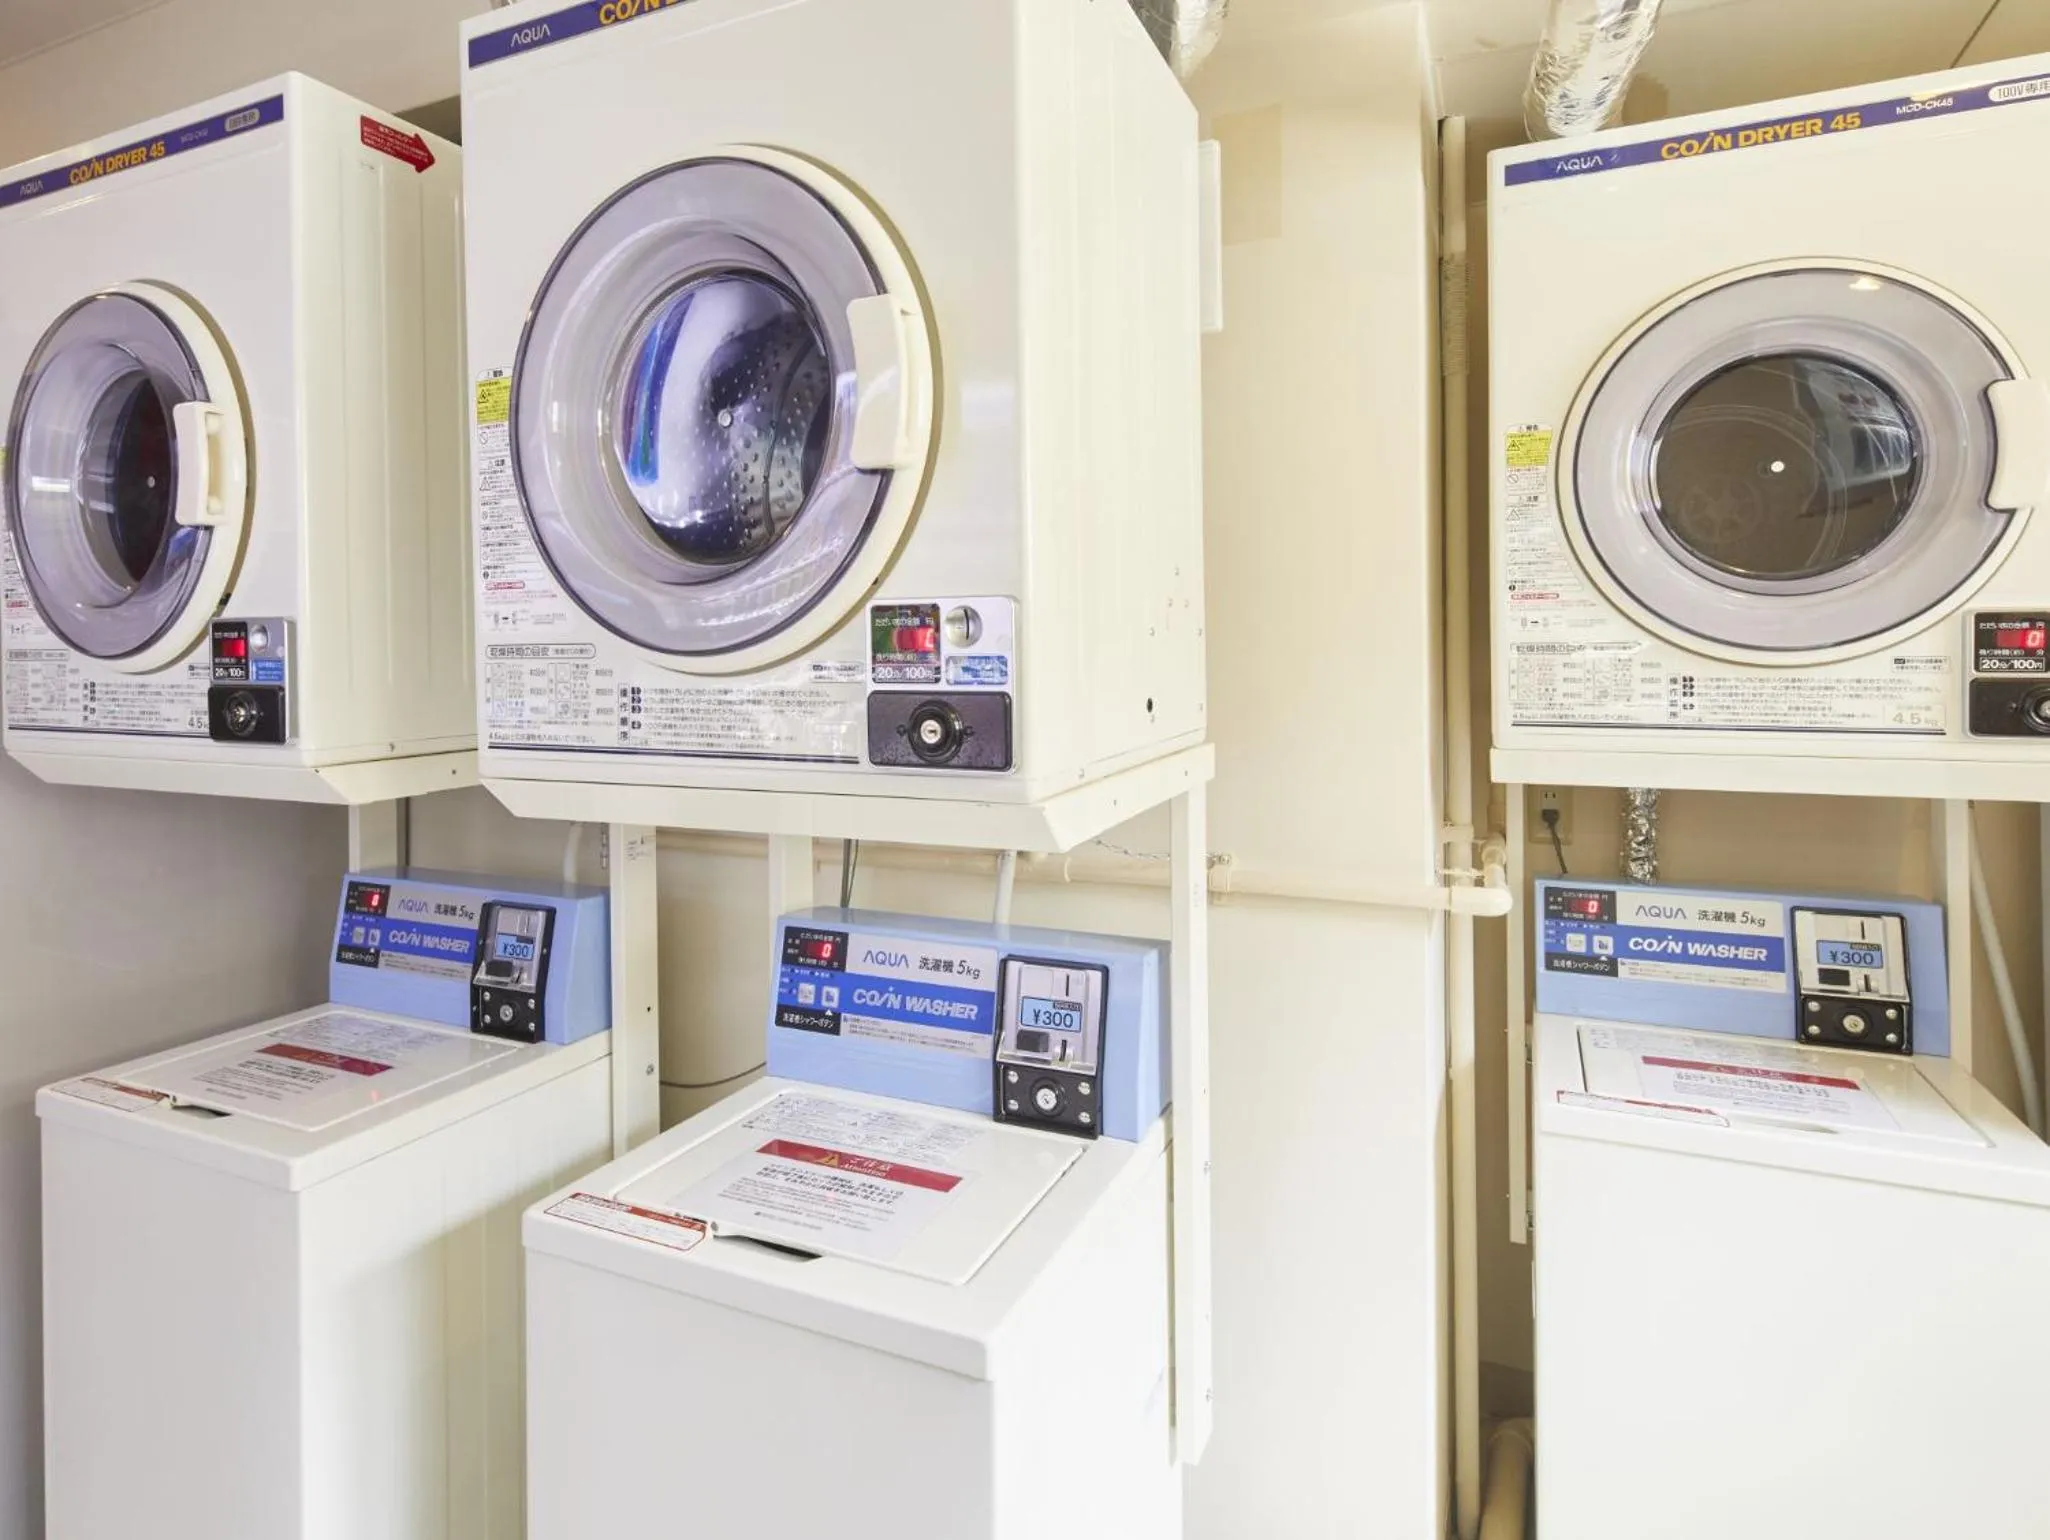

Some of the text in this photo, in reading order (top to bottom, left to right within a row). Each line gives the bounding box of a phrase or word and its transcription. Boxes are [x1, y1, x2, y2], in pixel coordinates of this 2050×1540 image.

[510, 24, 550, 47] AQUA
[1736, 117, 1823, 147] DRYER
[1830, 112, 1861, 130] 45
[106, 148, 148, 174] DRYER
[149, 141, 166, 158] 45
[1556, 154, 1604, 174] AQUA
[19, 180, 44, 196] AQUA
[2027, 630, 2041, 648] 0
[398, 898, 429, 914] AQUA
[458, 905, 476, 921] 5kg
[1588, 900, 1598, 913] 0
[1635, 904, 1687, 920] AQUA
[1697, 908, 1767, 928] 洗濯機 5kg
[422, 935, 471, 954] WASHER
[501, 944, 529, 958] ¥300
[821, 943, 832, 958] 0
[1687, 941, 1768, 961] WASHER
[863, 950, 910, 969] AQUA
[1829, 950, 1875, 966] ¥300
[918, 956, 981, 980] 洗濯機 5kg
[905, 995, 979, 1020] WASHER
[1033, 1008, 1074, 1028] ¥300
